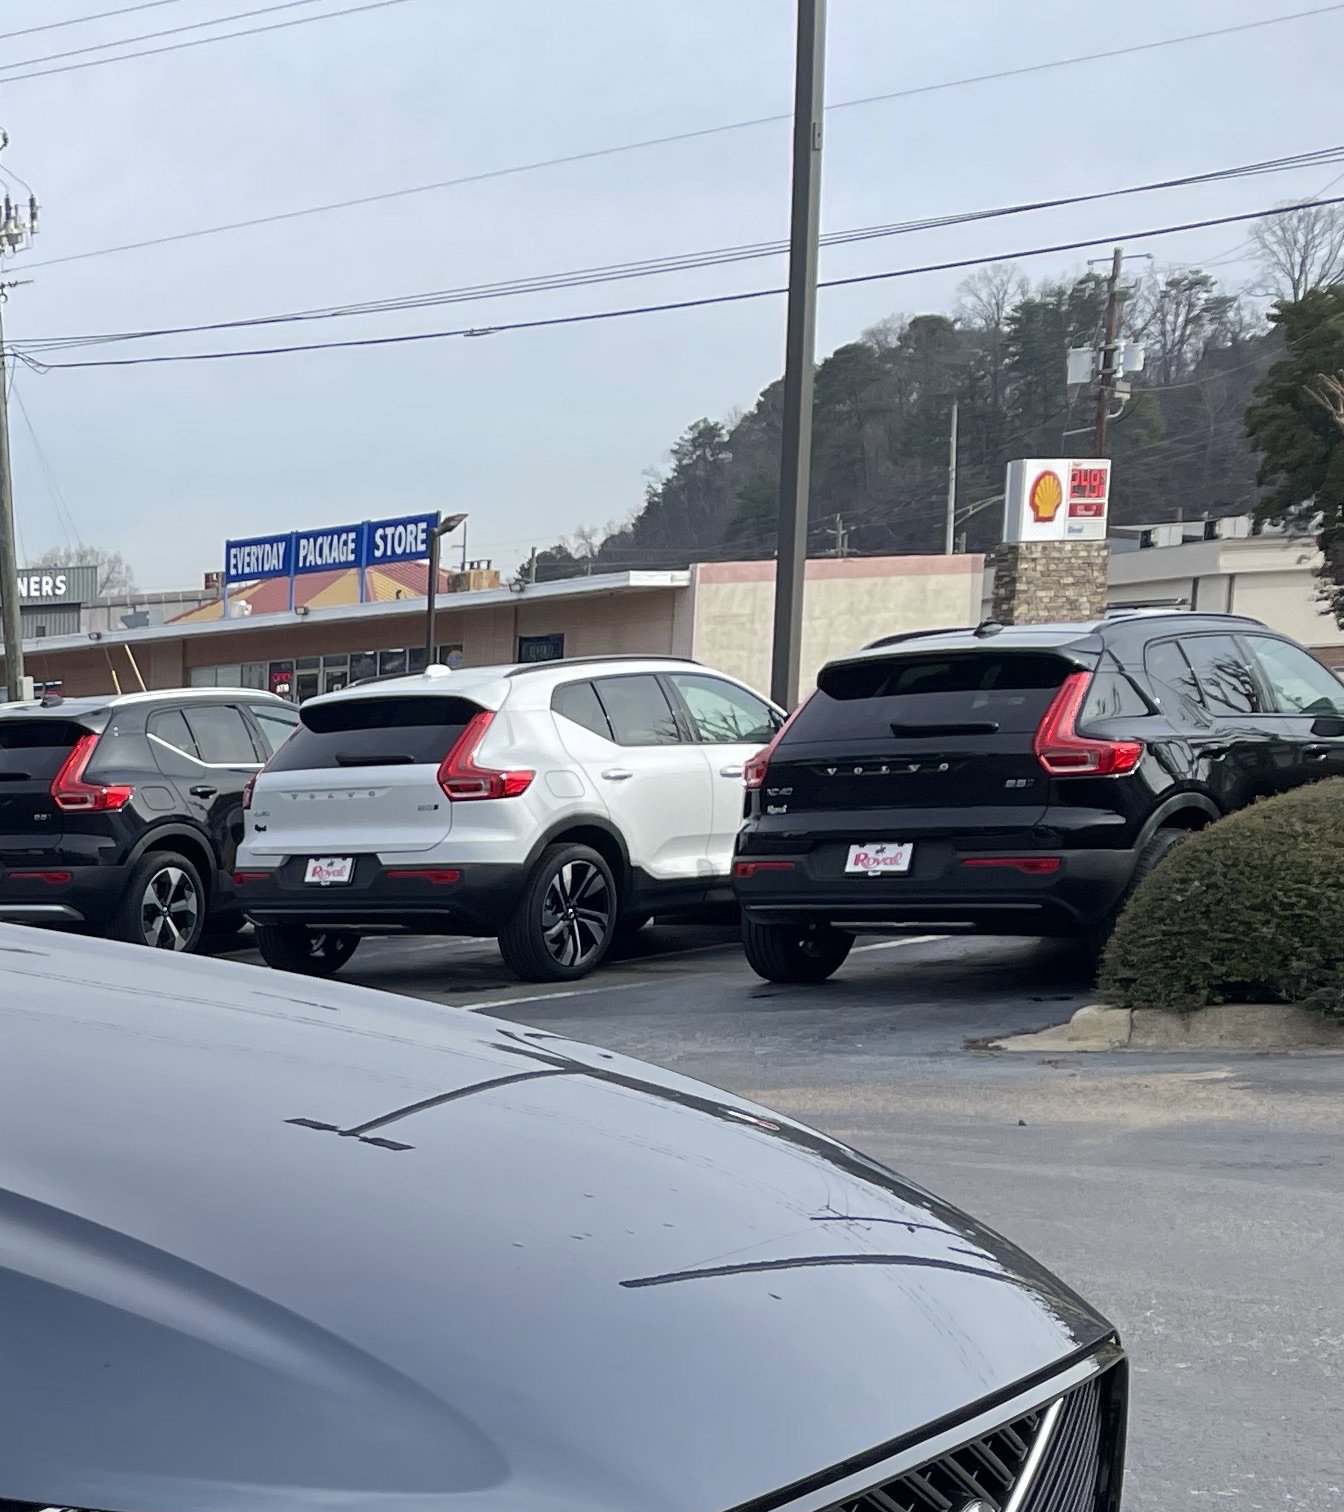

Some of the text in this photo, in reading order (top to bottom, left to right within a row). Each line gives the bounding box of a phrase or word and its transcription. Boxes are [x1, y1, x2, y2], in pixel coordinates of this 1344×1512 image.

[229, 521, 428, 576] EVERYDAY PACKAGE STORE
[826, 763, 949, 775] VOLVO
[853, 851, 903, 869] Royal
